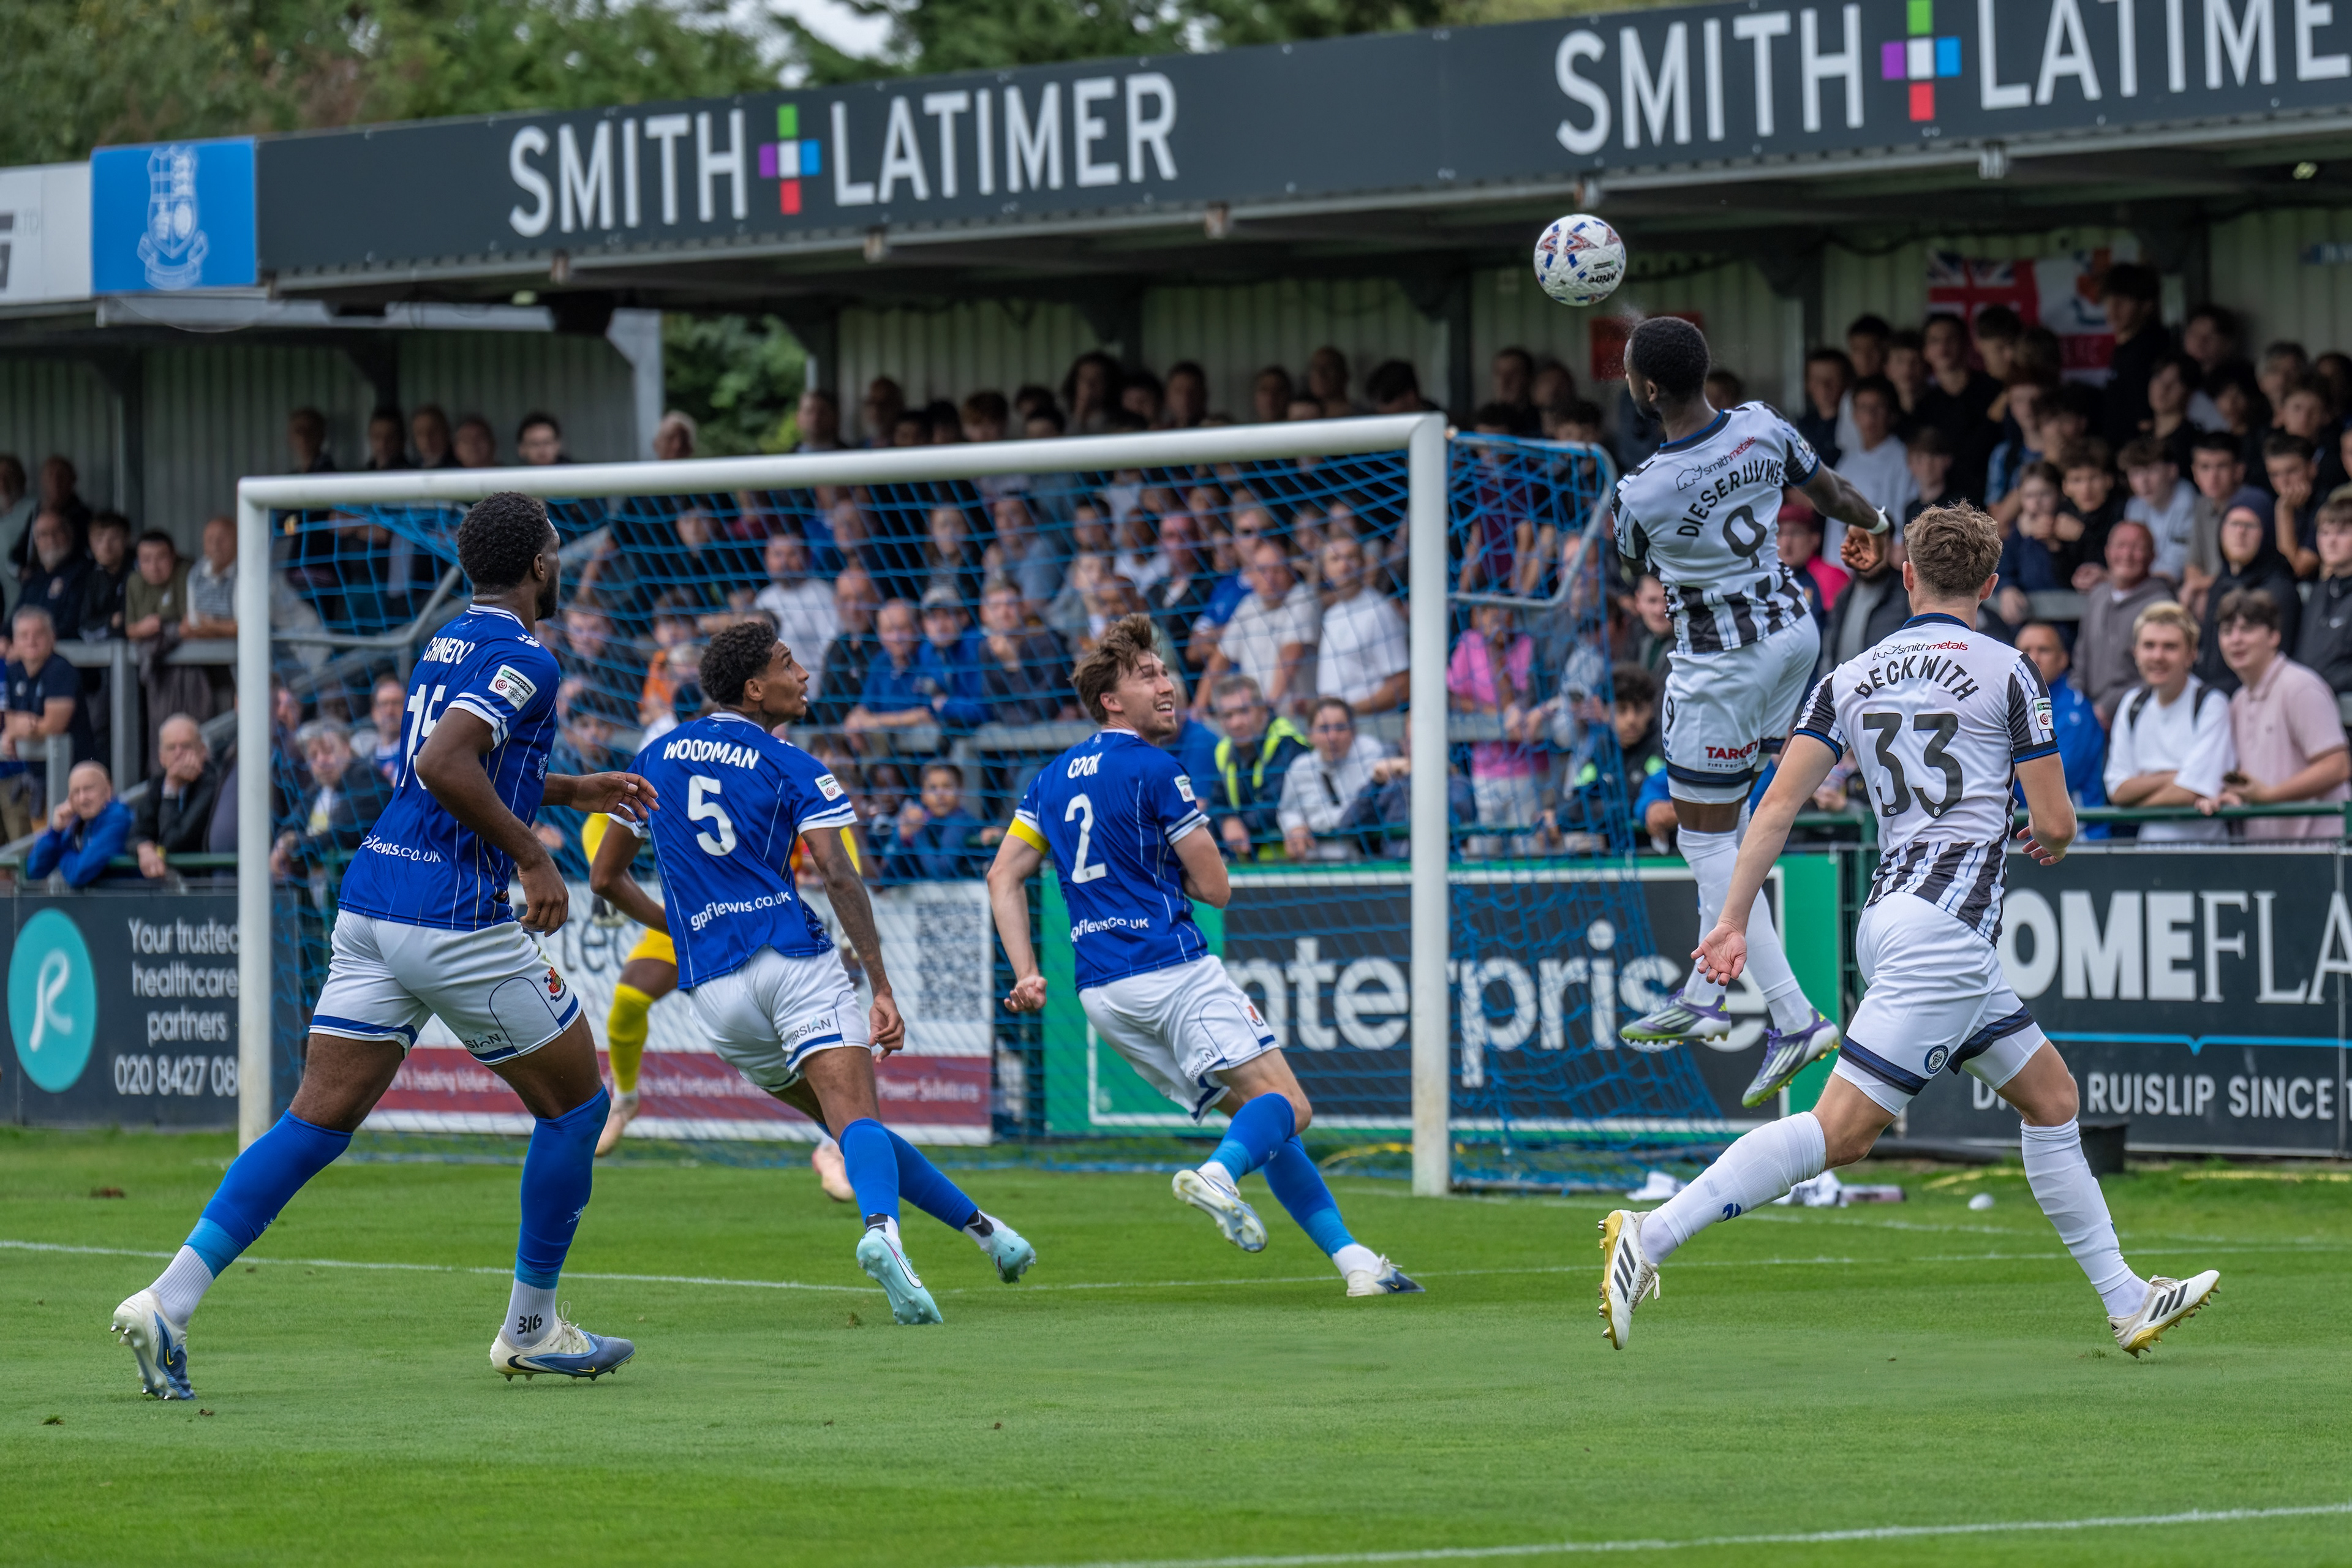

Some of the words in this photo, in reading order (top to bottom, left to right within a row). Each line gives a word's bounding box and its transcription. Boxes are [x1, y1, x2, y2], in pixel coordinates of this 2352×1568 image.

[1555, 7, 1864, 154] SMITH
[508, 109, 748, 238] SMITH
[830, 71, 1178, 206] LATIMER
[1703, 436, 1756, 475] smithmetals
[1898, 640, 1969, 655] smithmetals
[663, 738, 760, 771] WOODMAN
[1067, 752, 1103, 780] COOK
[1863, 712, 1964, 820] 33
[687, 774, 737, 857] 5
[1064, 793, 1107, 884] 2
[128, 918, 172, 954] Your
[132, 962, 238, 997] healthcare
[147, 1005, 229, 1046] partners
[115, 1054, 154, 1095] 020
[157, 1054, 208, 1096] 8427
[2087, 1072, 2215, 1117] RUISLIP
[2228, 1075, 2334, 1120] SINCE
